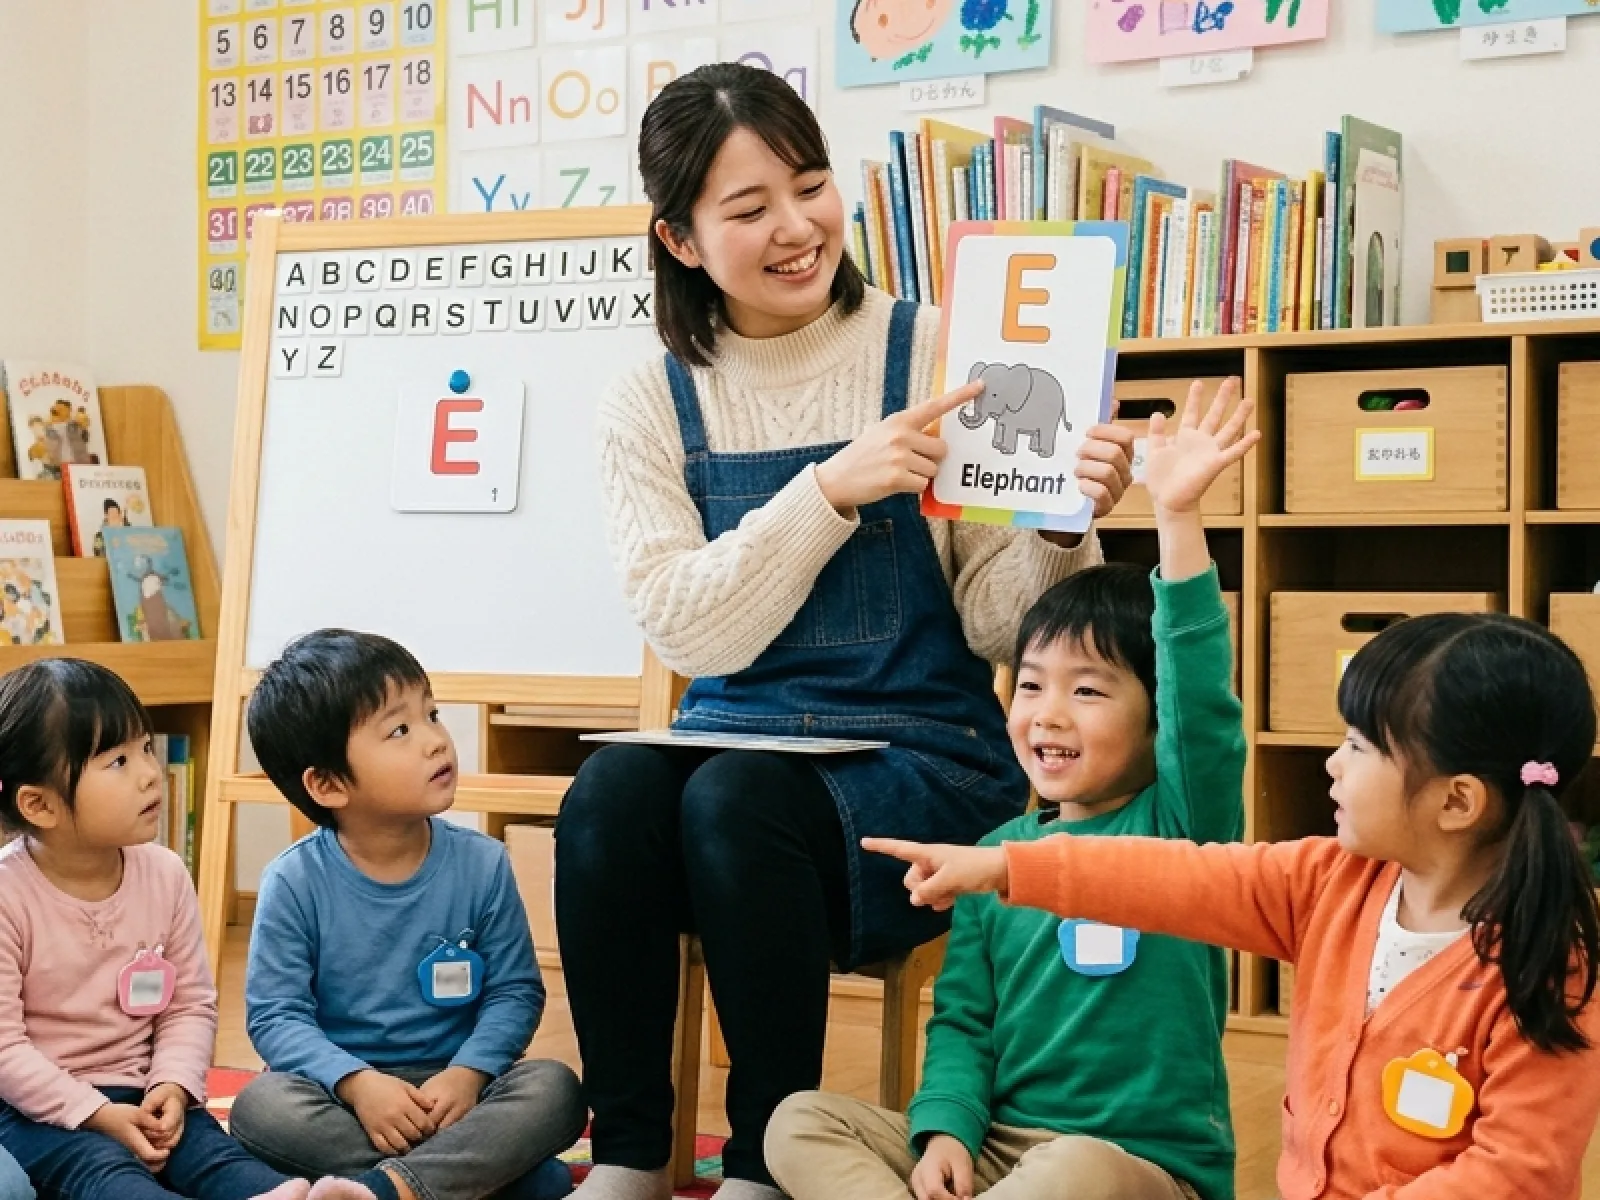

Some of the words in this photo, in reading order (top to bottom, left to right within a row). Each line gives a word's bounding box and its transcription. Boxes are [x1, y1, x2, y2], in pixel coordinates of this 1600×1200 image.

[216, 28, 232, 55] 5
[253, 23, 269, 51] 6
[291, 18, 305, 45] 7
[329, 13, 345, 41] 8
[369, 9, 385, 37] 9
[403, 3, 432, 31] 10
[211, 81, 237, 109] 13
[247, 77, 273, 103] 14
[285, 73, 311, 101] 15
[323, 67, 351, 95] 16
[363, 63, 391, 91] 17
[403, 59, 431, 85] 18
[467, 80, 531, 129] Nn
[547, 70, 619, 119] Oo
[209, 157, 235, 182] 21
[246, 152, 274, 177] 22
[283, 148, 313, 174] 23
[323, 144, 352, 171] 23
[362, 139, 389, 166] 24
[401, 136, 432, 162] 25
[363, 198, 390, 219] 39
[1001, 253, 1057, 344] E
[429, 397, 484, 476] E
[961, 463, 1066, 496] Elephant
